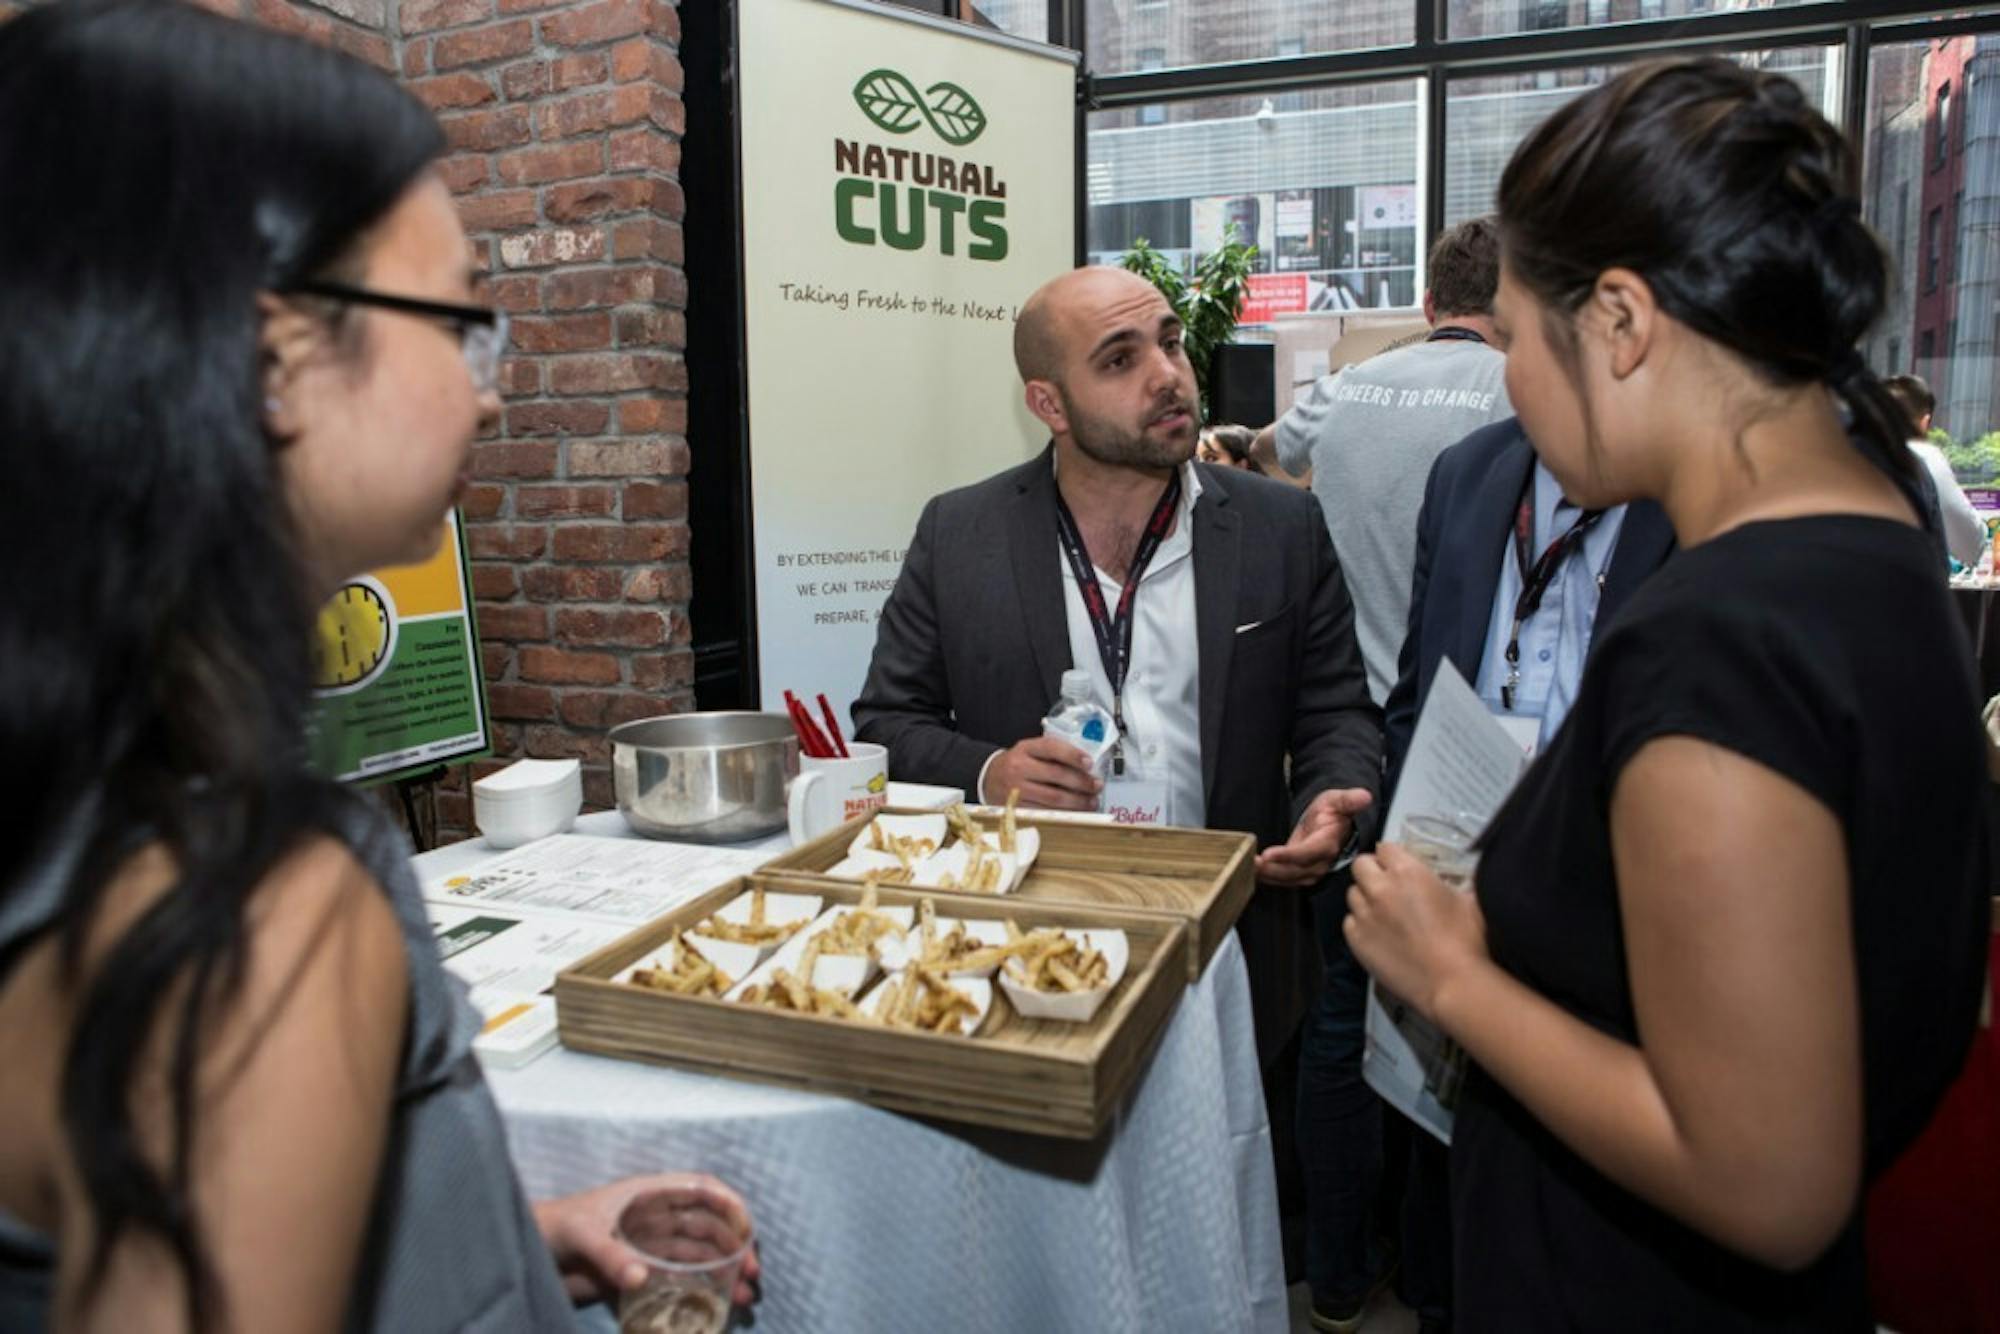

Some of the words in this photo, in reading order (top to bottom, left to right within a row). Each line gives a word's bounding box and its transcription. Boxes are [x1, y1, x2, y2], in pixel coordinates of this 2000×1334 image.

[835, 138, 1006, 198] NATURAL
[835, 178, 1008, 262] CUTS
[779, 284, 849, 310] Taking
[857, 290, 907, 311] Fresh
[912, 296, 926, 311] to
[931, 298, 957, 317] the
[963, 303, 1006, 322] Next
[1338, 383, 1394, 407] CHEERS
[1398, 389, 1420, 408] TO
[1422, 388, 1494, 412] CHANGE
[777, 554, 796, 567] BY
[797, 550, 868, 566] EXTENDING
[870, 550, 891, 563] THE
[796, 584, 817, 597] WE
[821, 582, 848, 595] CAN
[814, 609, 870, 625] PREPARE,
